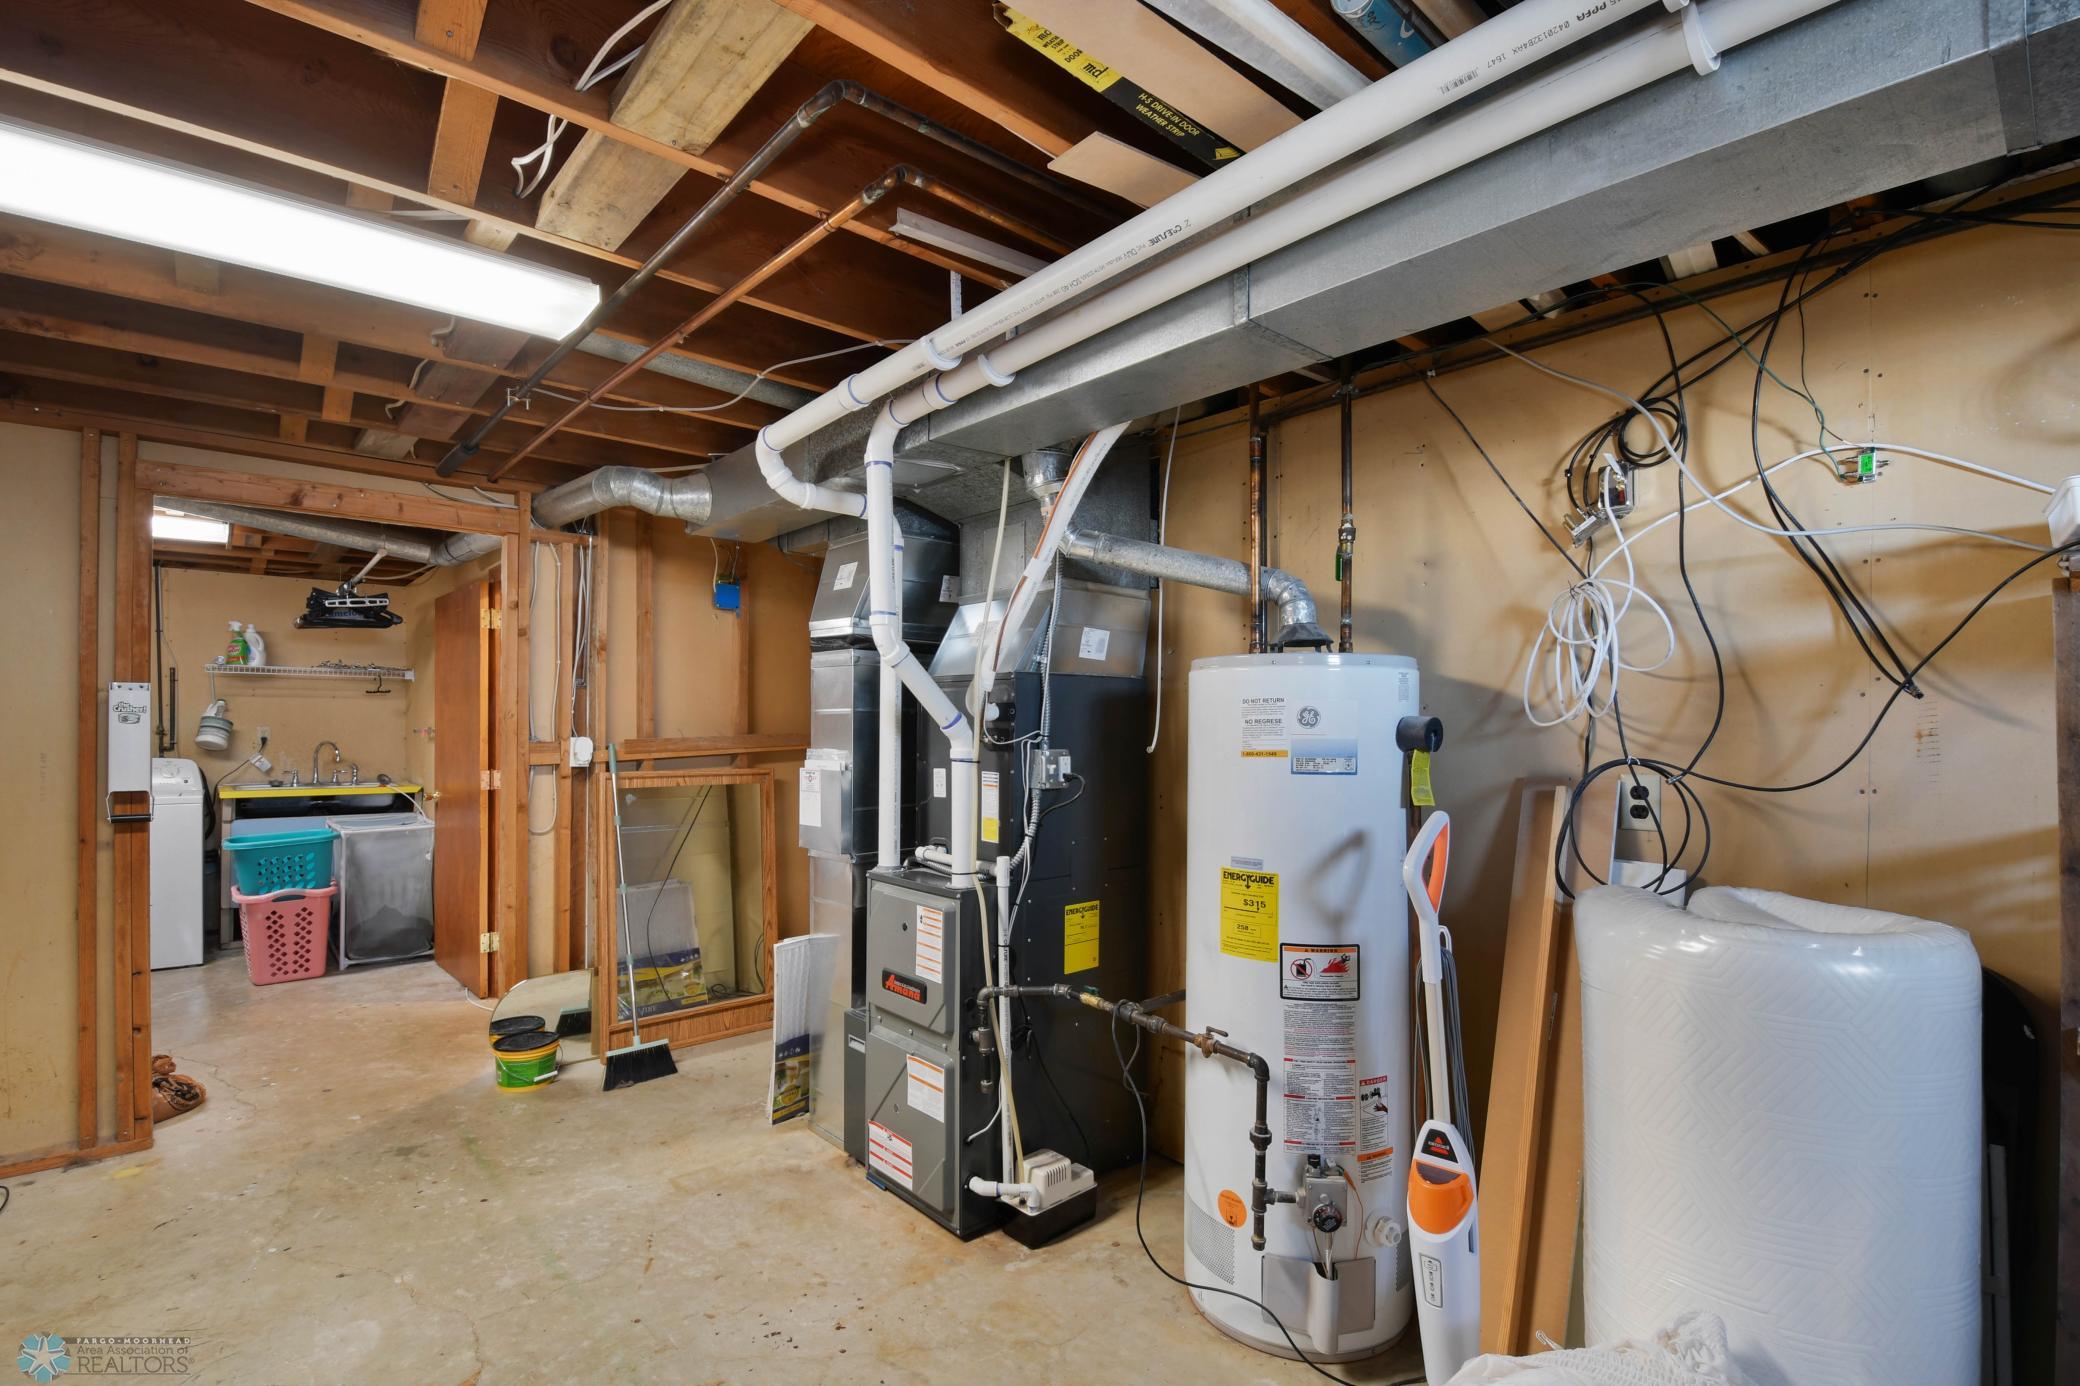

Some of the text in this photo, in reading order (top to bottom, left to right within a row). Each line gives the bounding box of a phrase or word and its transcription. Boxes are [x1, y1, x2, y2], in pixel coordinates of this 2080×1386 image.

[1576, 2, 1607, 21] PPFA
[1136, 103, 1185, 137] WEATHER STRIP
[1151, 101, 1182, 123] DRIVE-IN
[1179, 120, 1200, 137] DOOR
[1223, 871, 1275, 886] ENERGYGUIDE
[1243, 899, 1267, 910] $315
[886, 974, 921, 1001] Amana
